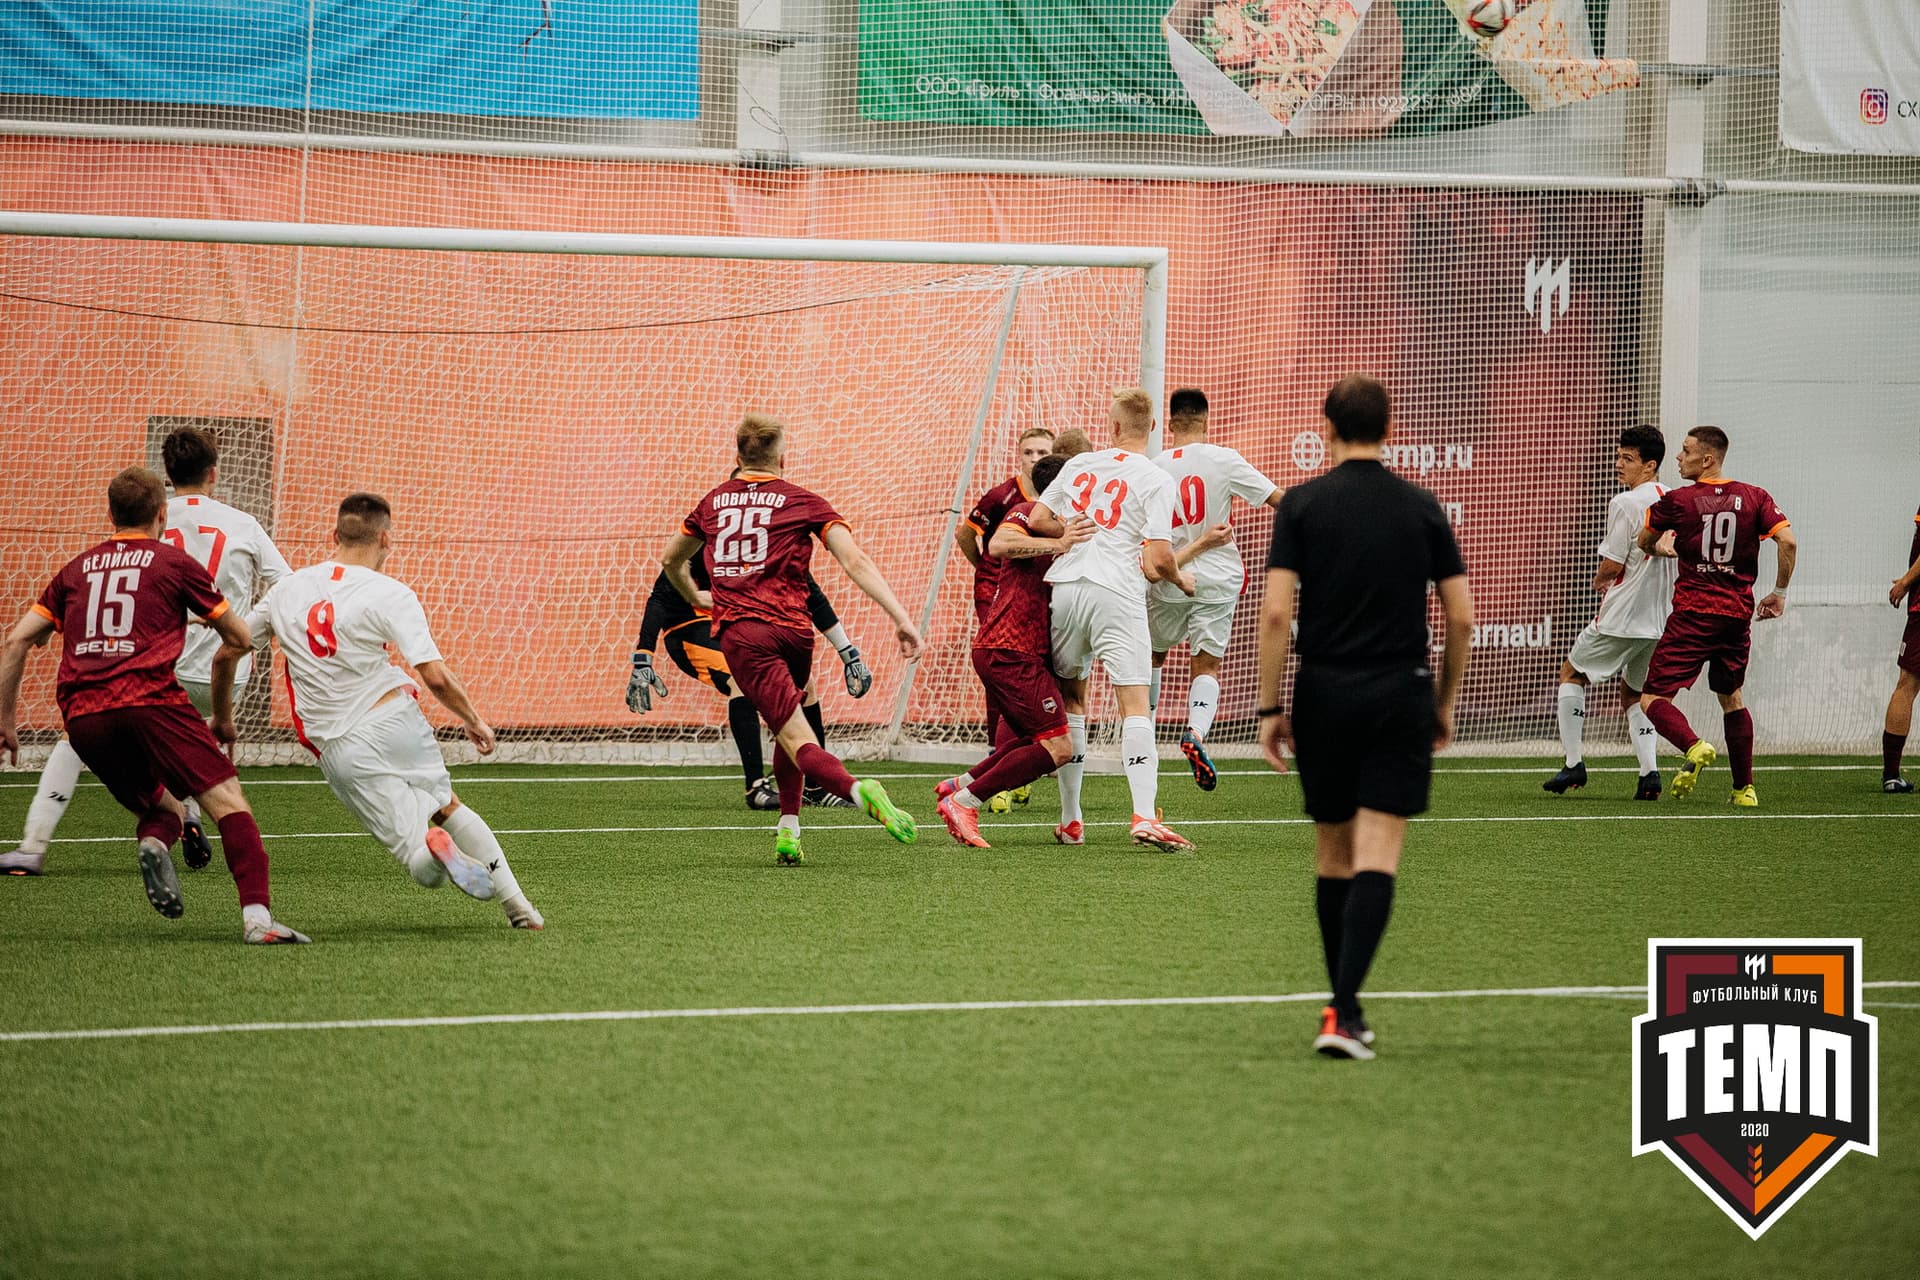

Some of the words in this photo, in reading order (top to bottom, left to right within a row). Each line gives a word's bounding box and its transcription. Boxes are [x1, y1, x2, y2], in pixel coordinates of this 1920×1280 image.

[916, 76, 960, 95] ООО
[712, 491, 787, 511] НОВИЧКОВ
[1071, 472, 1128, 530] 33
[713, 506, 773, 563] 25
[1701, 511, 1737, 563] 19
[82, 549, 155, 574] БЕЛИКОВ
[85, 568, 141, 640] 15
[75, 639, 136, 656] SEUS
[306, 600, 338, 659] 8
[1128, 756, 1148, 767] 2K
